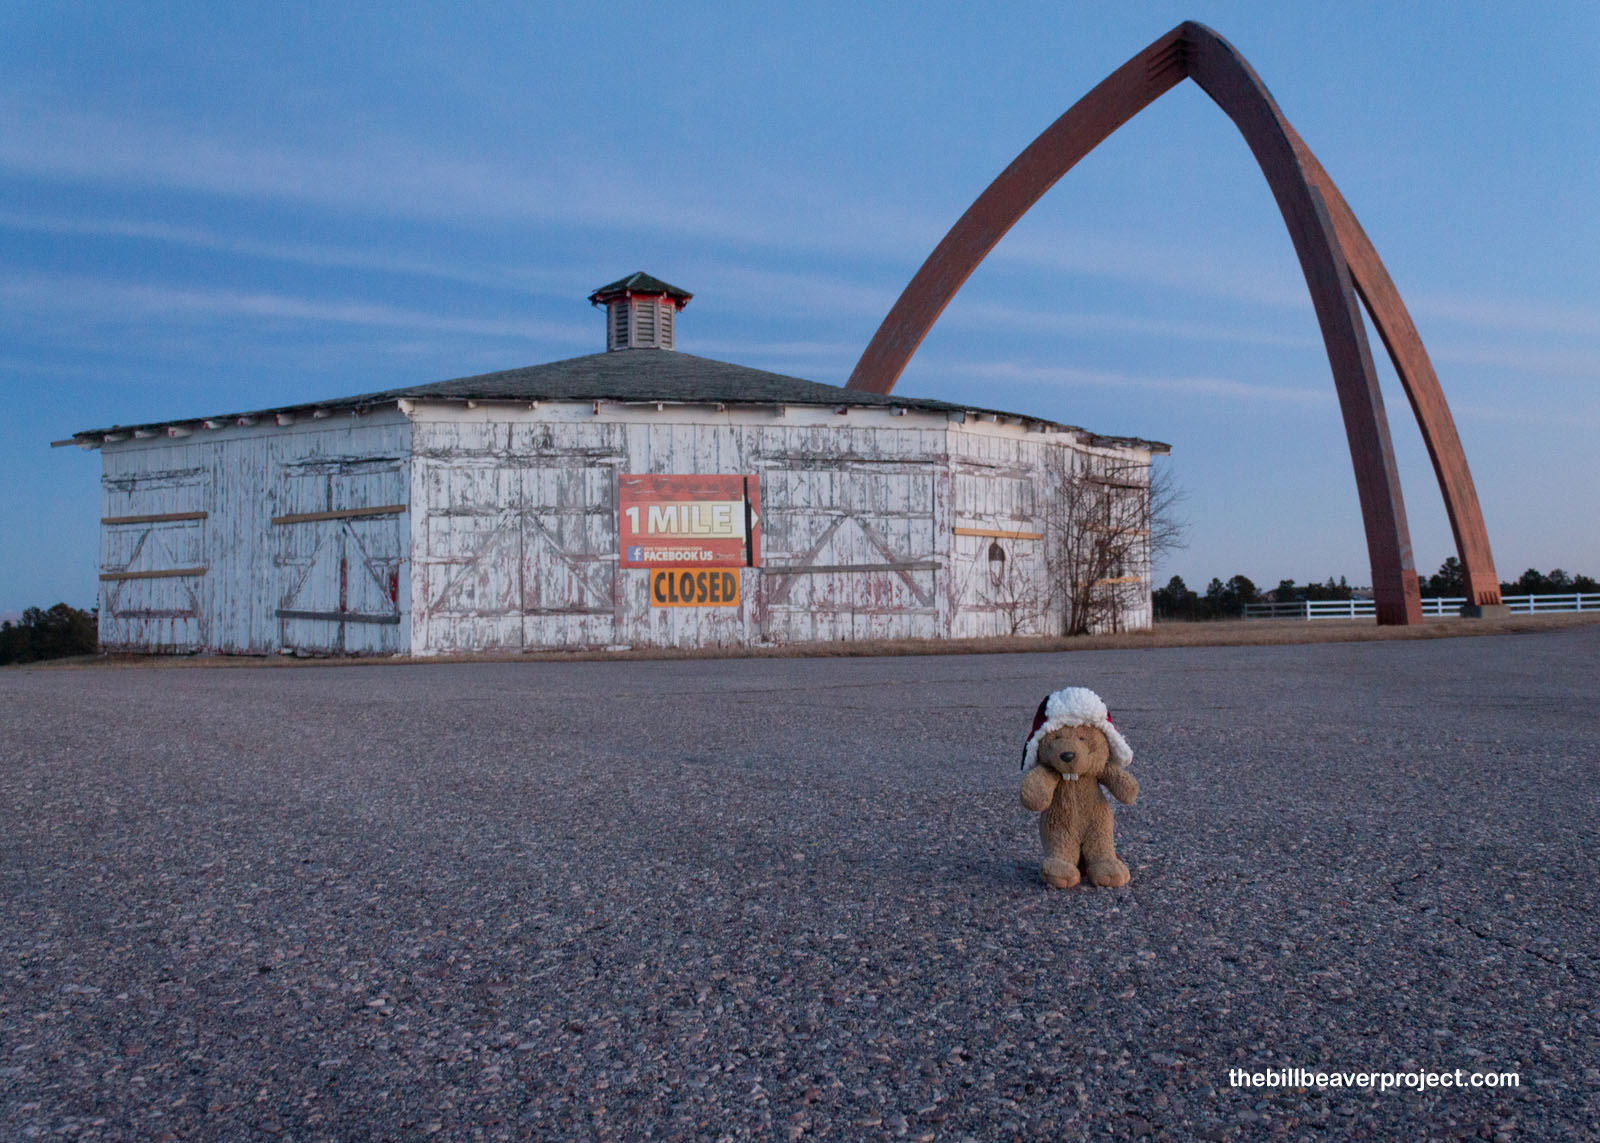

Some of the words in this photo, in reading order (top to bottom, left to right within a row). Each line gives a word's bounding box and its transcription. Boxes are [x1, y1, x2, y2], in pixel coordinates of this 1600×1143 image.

[625, 506, 640, 534] 1
[647, 505, 732, 534] MILE
[644, 551, 697, 561] FACEBOOK
[699, 551, 713, 561] US
[654, 572, 736, 603] CLOSED
